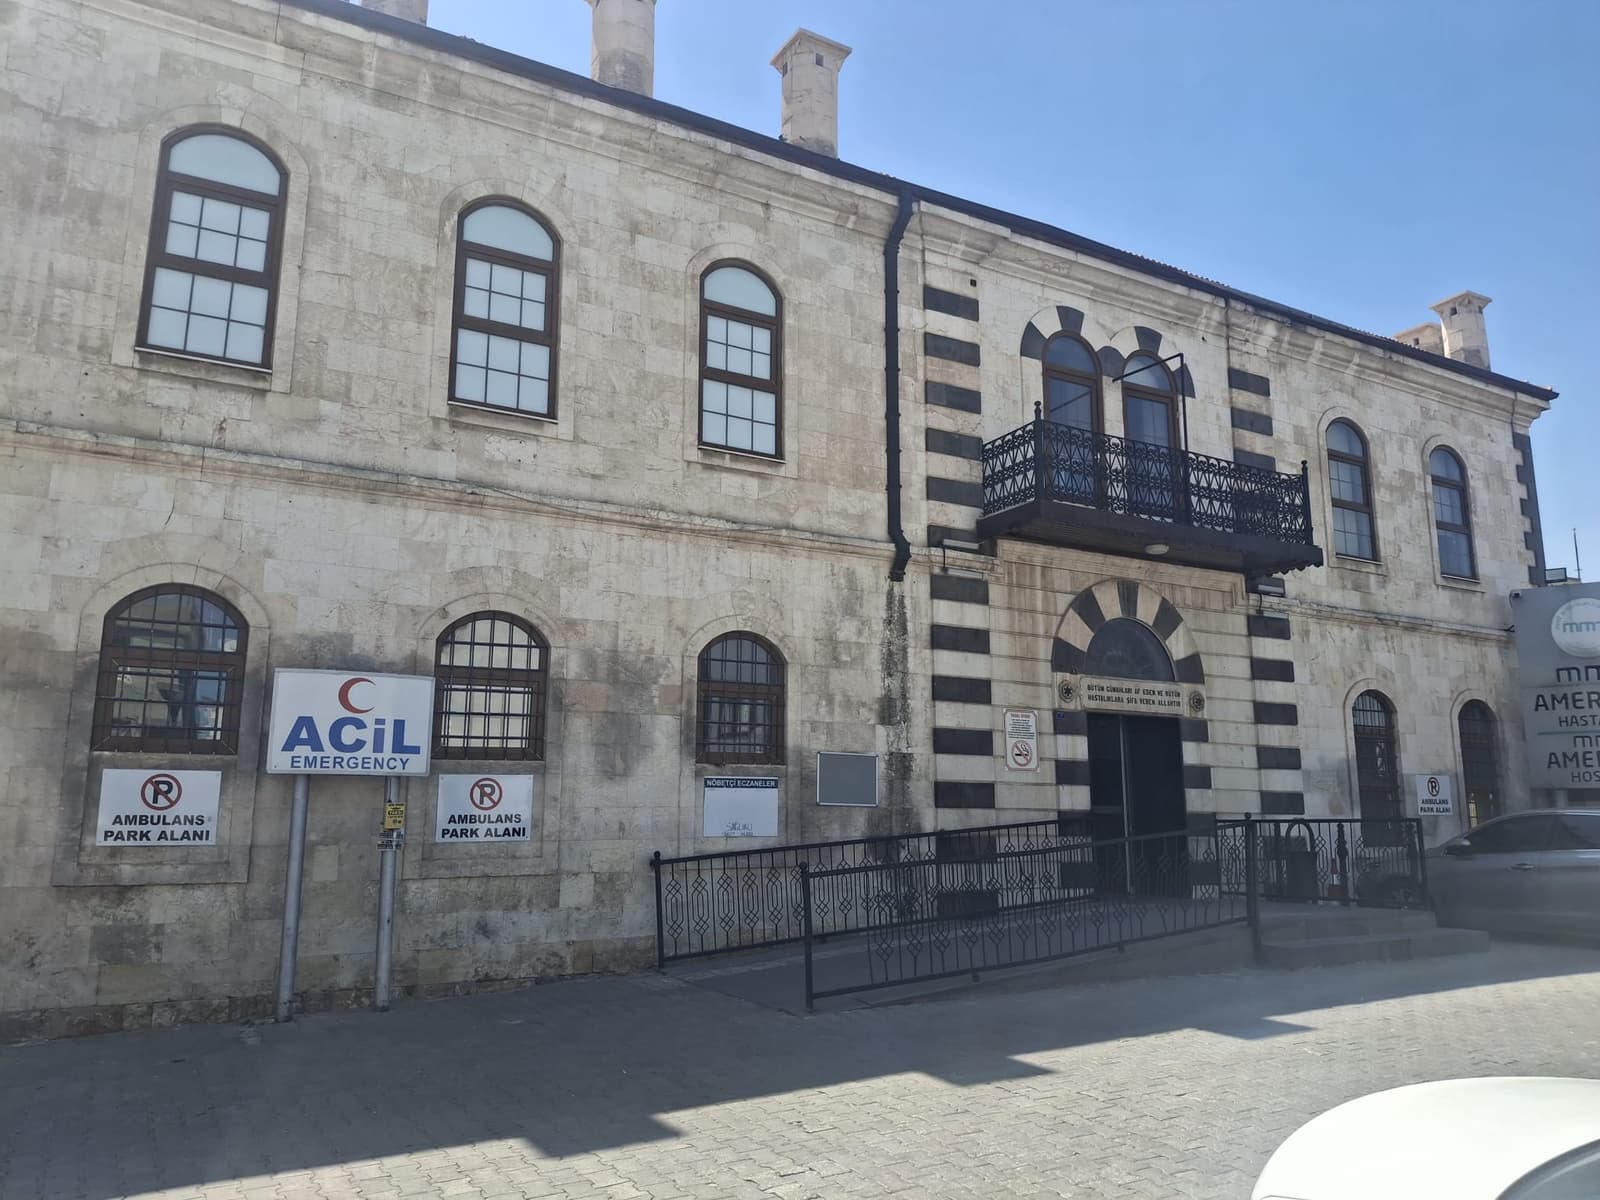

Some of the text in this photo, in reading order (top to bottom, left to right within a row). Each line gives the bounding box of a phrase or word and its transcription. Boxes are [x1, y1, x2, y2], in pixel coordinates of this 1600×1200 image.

[1558, 715, 1600, 728] HAST
[290, 755, 410, 771] EMERGENCY
[1546, 751, 1600, 769] AME
[706, 778, 736, 788] NÖBETÇİ
[112, 814, 205, 826] AMBULANS
[447, 814, 522, 825] AMBULANS
[103, 830, 210, 841] PARK ALANI
[441, 827, 526, 839] PARK ALANI
